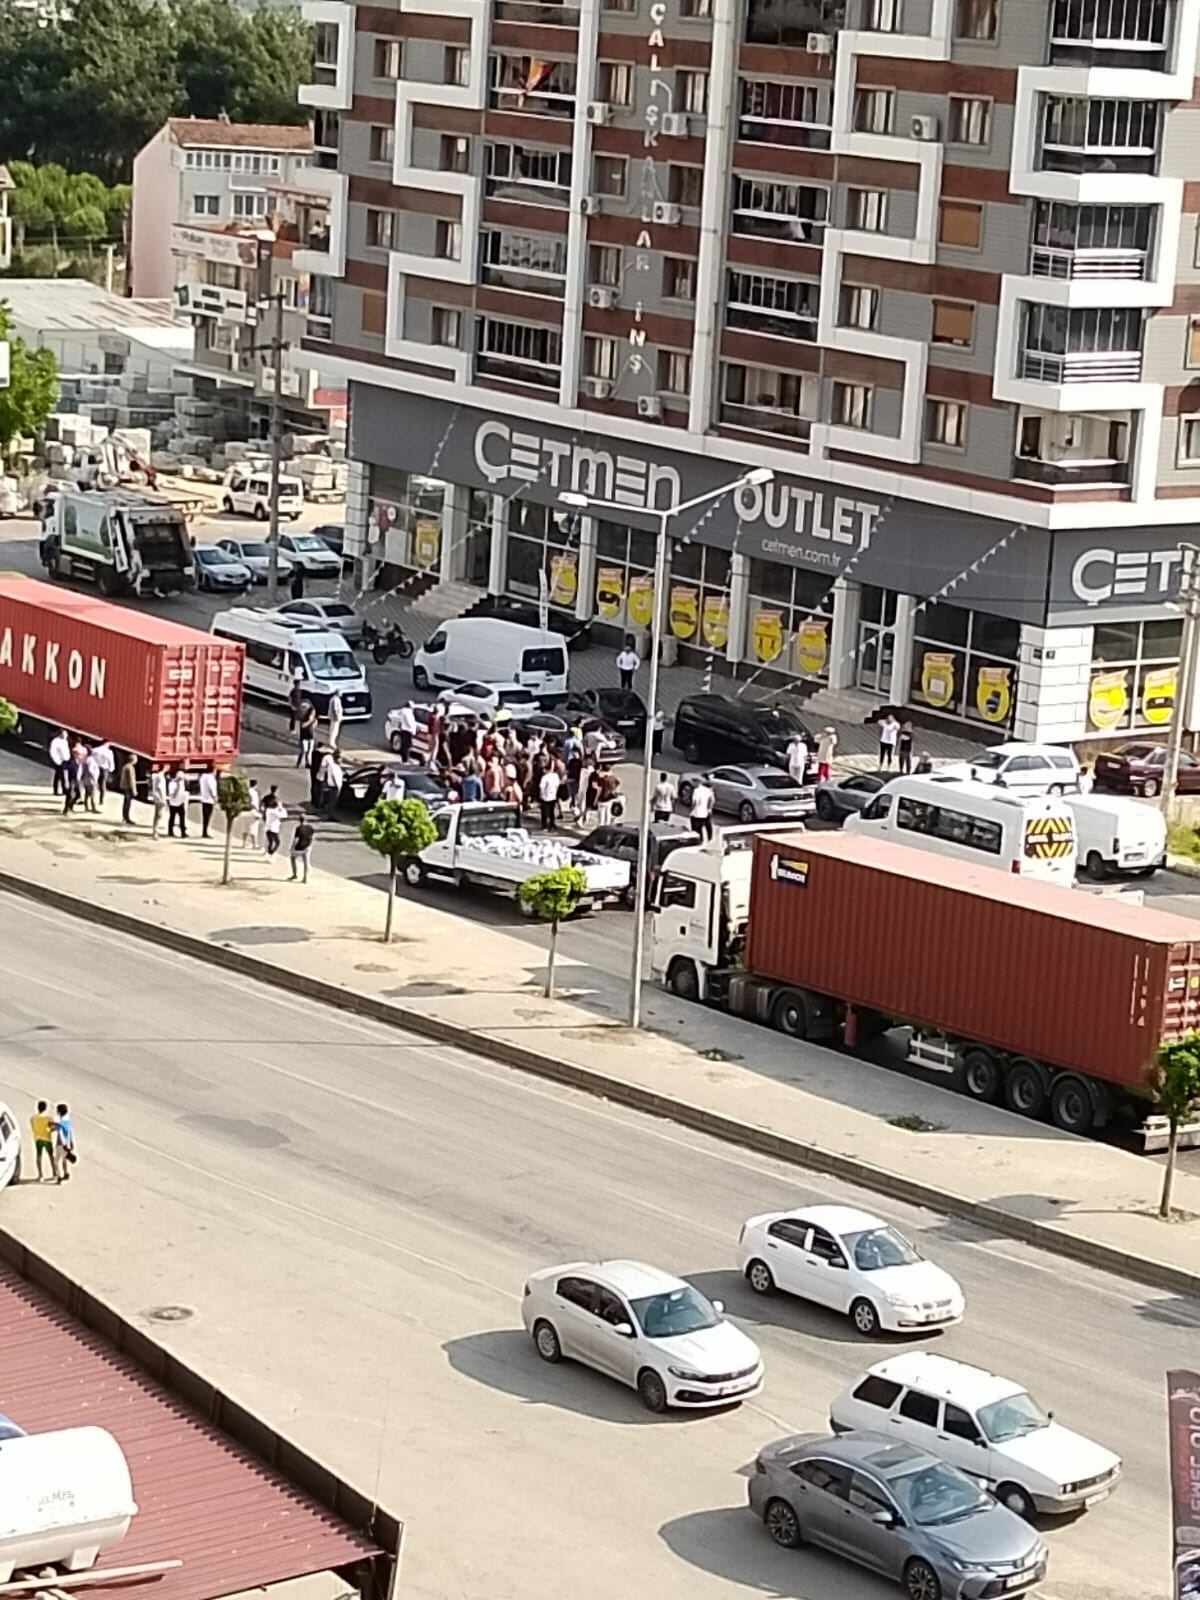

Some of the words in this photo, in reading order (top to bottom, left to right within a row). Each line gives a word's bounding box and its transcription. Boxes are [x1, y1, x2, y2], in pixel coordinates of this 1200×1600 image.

[733, 482, 880, 549] OUTLET
[761, 538, 842, 568] cetmen.com.tr
[1072, 548, 1200, 607] ÇET
[0, 627, 106, 699] AKKON
